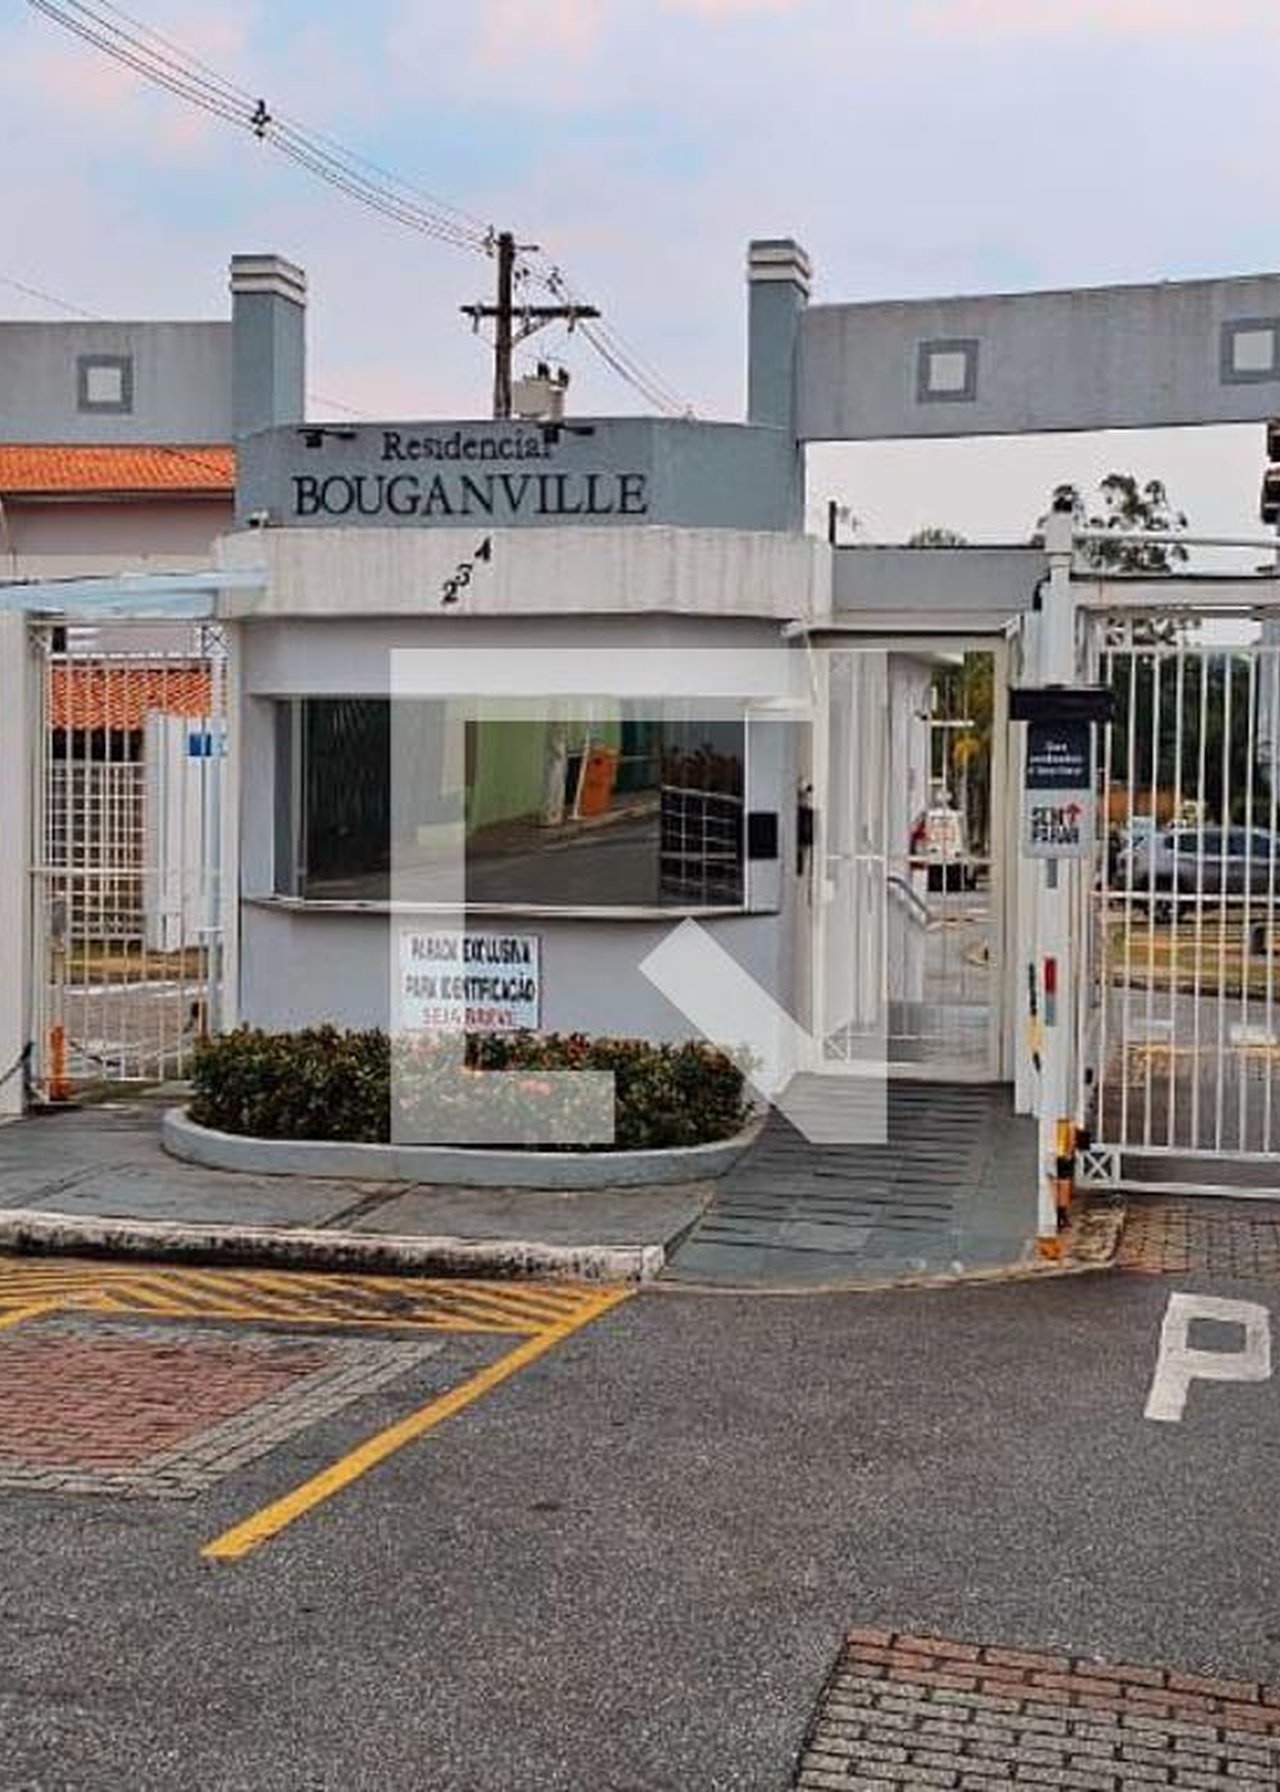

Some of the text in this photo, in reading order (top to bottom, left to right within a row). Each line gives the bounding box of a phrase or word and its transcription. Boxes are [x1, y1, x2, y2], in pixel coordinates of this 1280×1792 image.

[381, 429, 552, 461] Residencial
[292, 473, 647, 517] BOUGANVILLE
[411, 937, 458, 961] PARADA
[405, 974, 438, 999] PARA
